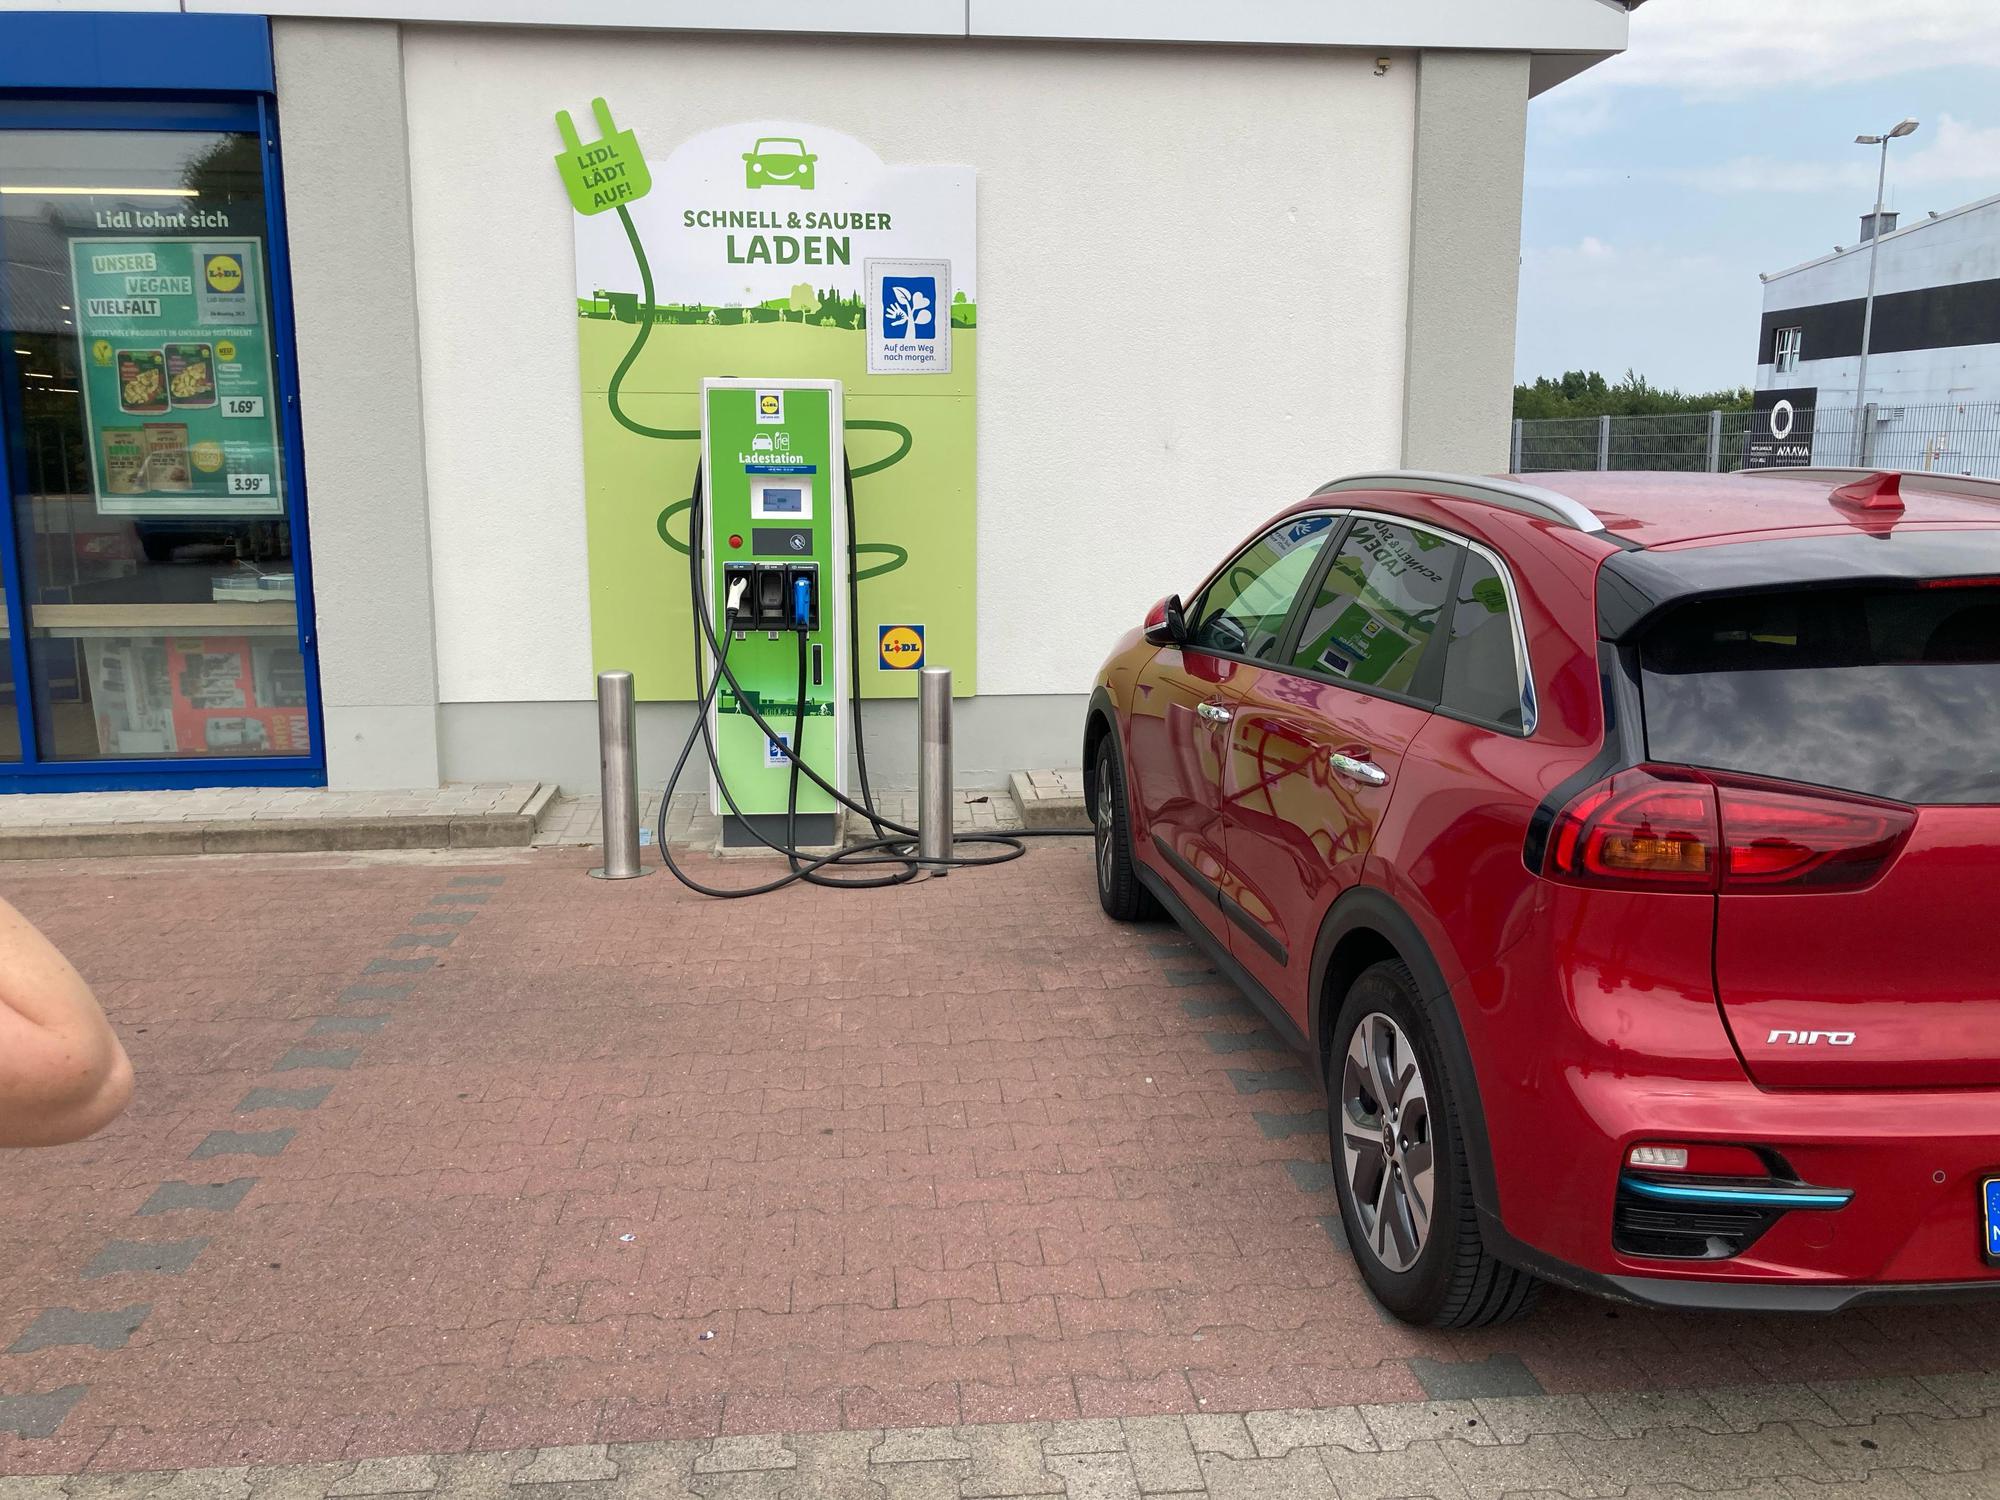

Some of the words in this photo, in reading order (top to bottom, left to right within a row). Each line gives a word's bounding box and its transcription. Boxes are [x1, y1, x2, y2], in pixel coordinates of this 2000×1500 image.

[577, 145, 619, 170] LIDL
[582, 162, 626, 189] LÄDT
[593, 182, 633, 208] AUF!
[96, 211, 131, 228] Lidl
[136, 211, 186, 228] lohnt
[191, 211, 229, 228] sich
[683, 210, 782, 229] SCHNELL
[786, 212, 801, 229] &
[804, 211, 892, 230] SAUBER
[726, 235, 851, 266] LADEN
[95, 255, 154, 272] UNSERE
[208, 267, 240, 278] LIDL
[128, 278, 190, 293] VEGANE
[90, 301, 157, 315] VIELFALT
[883, 344, 898, 354] Auf
[900, 344, 916, 353] dem
[917, 344, 935, 355] Weg
[884, 352, 903, 361] nach
[905, 354, 936, 363] morgen.
[739, 453, 803, 464] Ladestation
[884, 640, 919, 653] LIDL
[1767, 1029, 1856, 1045] niro
